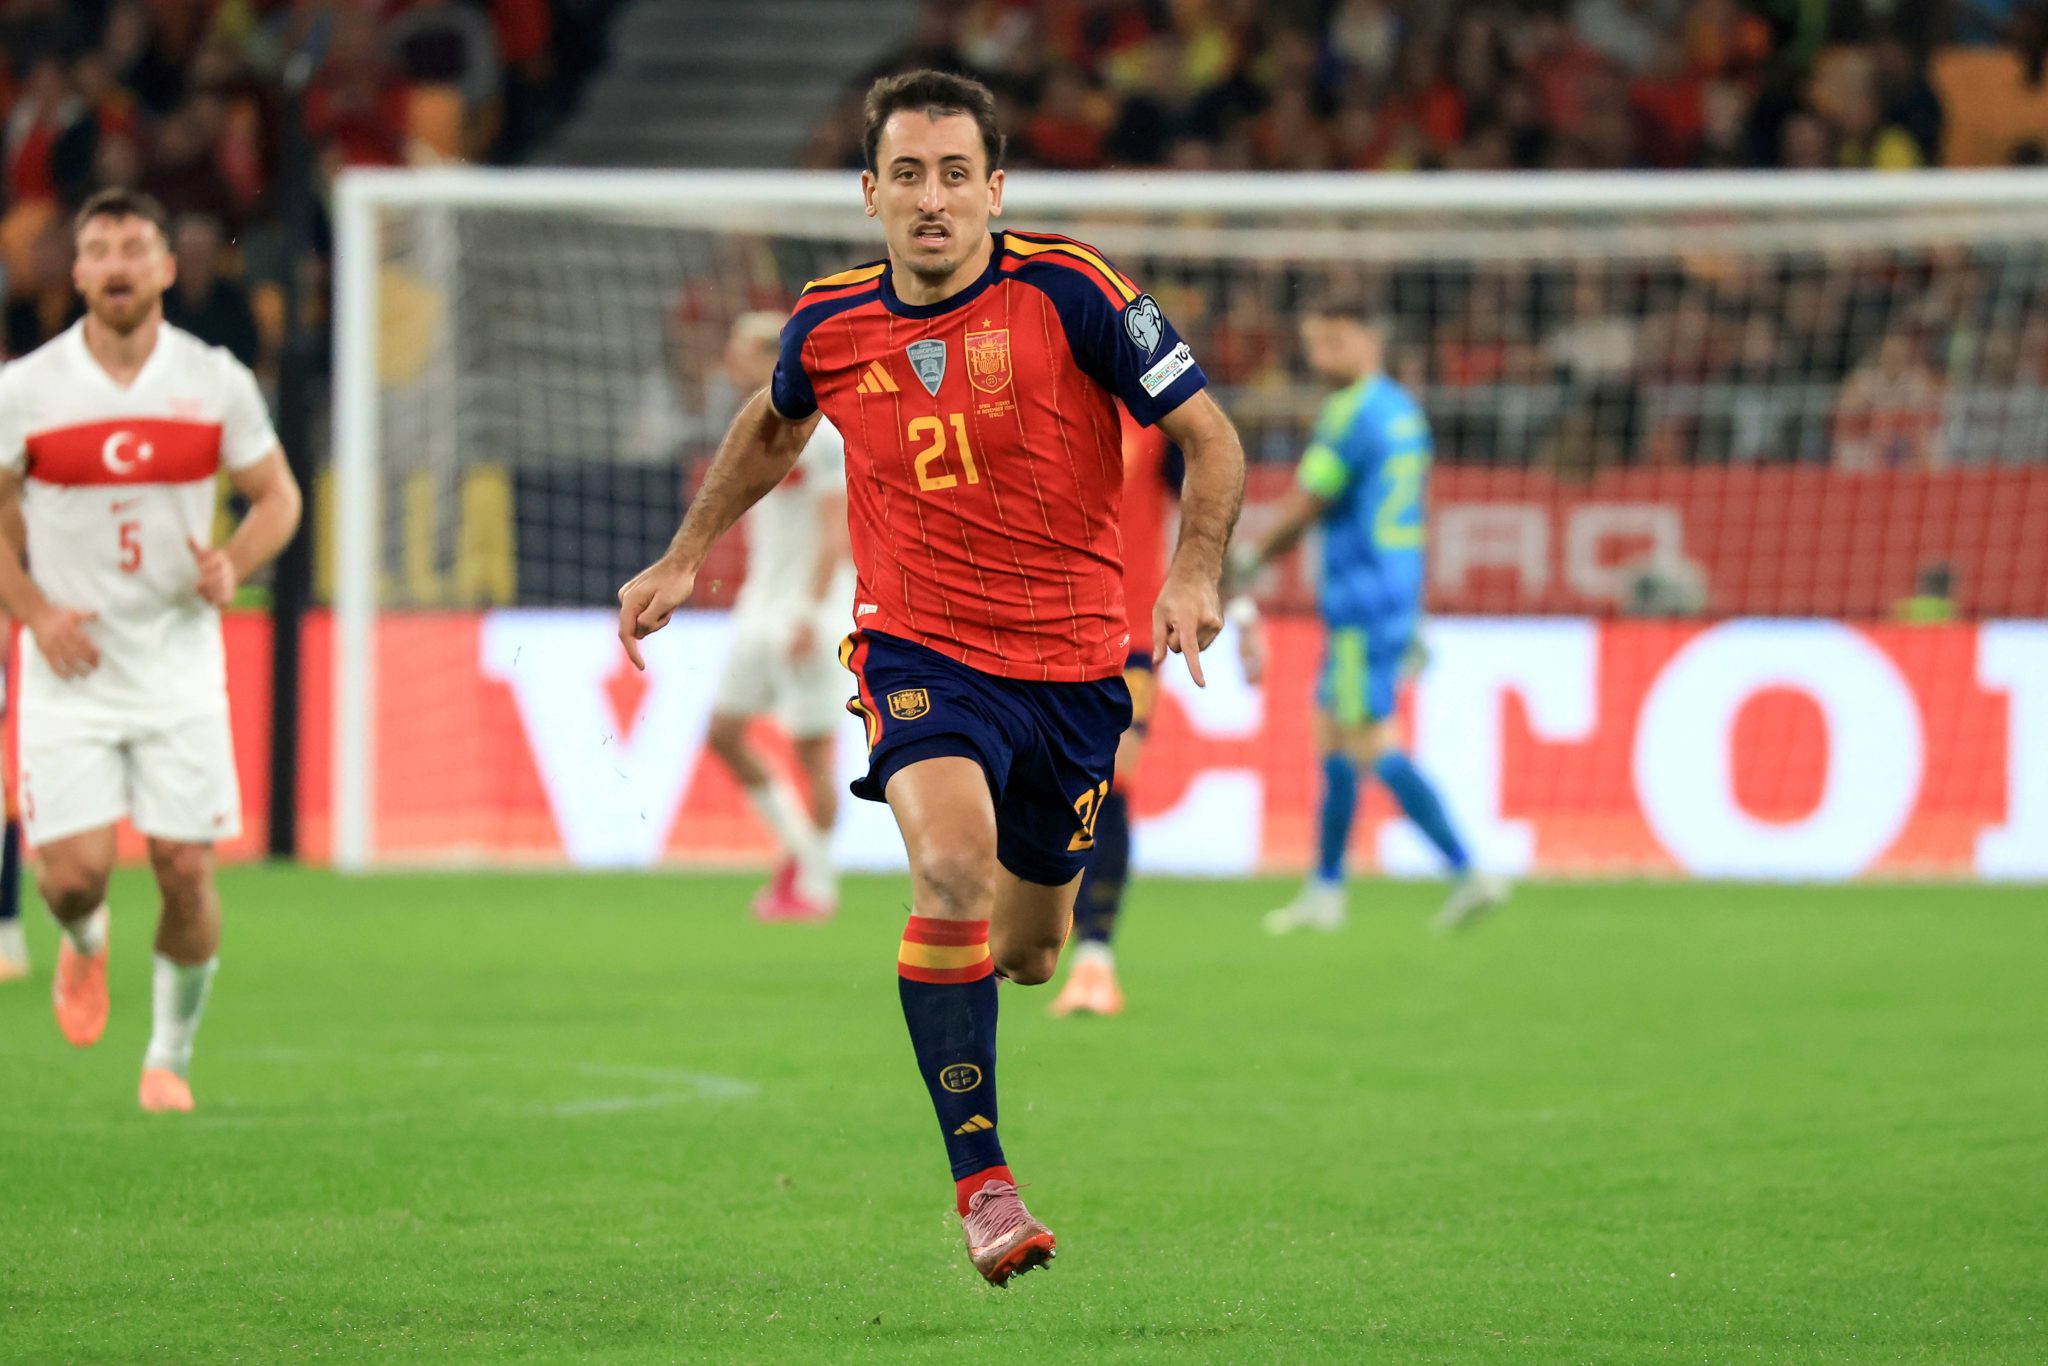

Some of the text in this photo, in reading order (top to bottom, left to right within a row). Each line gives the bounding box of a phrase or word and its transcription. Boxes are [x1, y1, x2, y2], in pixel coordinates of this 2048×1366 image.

[908, 413, 979, 492] 21
[118, 520, 142, 575] 5
[1067, 779, 1108, 851] 21
